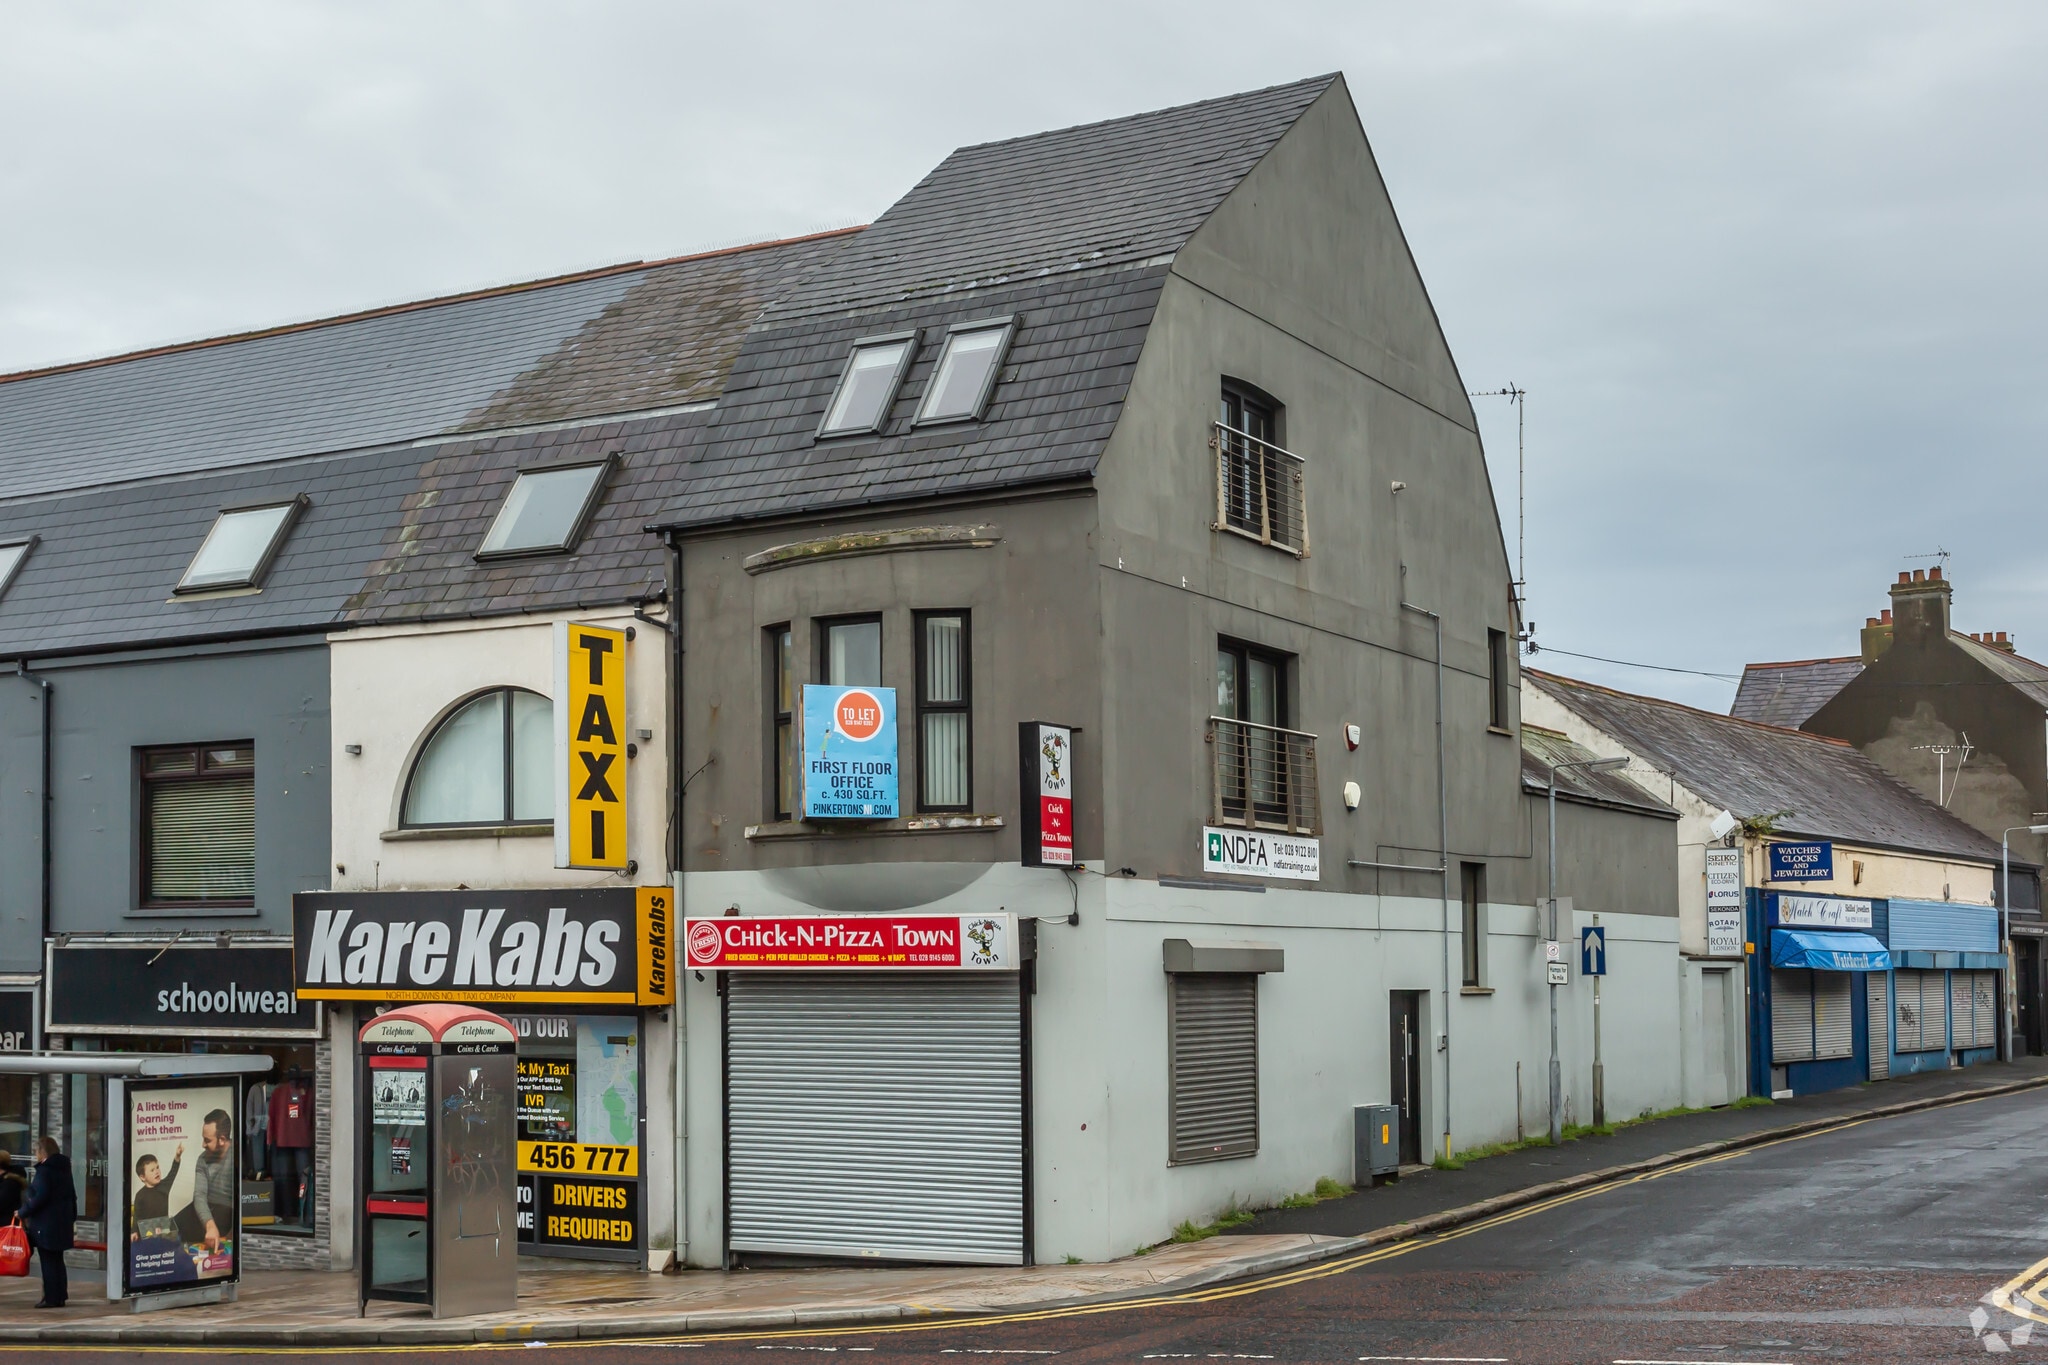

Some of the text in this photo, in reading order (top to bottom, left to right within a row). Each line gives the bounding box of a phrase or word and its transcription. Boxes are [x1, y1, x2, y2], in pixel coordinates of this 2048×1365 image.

[842, 707, 875, 721] TO LET
[576, 633, 619, 859] TAXI
[812, 761, 892, 775] FIRST FLOOR
[831, 776, 874, 788] OFFICE
[821, 789, 887, 801] c. 430 SQ.FT.
[813, 803, 892, 815] PINKERTONSNI.COM
[1222, 834, 1268, 866] NDFA
[1284, 844, 1294, 856] 028
[1778, 846, 1821, 854] WATCHES
[1707, 854, 1737, 862] SEIKO
[1781, 855, 1819, 863] CLOCKS
[1707, 872, 1738, 880] CITIZEN
[1774, 868, 1829, 878] JEWELLERY
[1713, 890, 1739, 898] LORUS
[1708, 919, 1740, 927] ROTARY
[1710, 937, 1740, 945] ROYAL
[837, 953, 850, 962] PIZZA
[887, 954, 906, 962] WRAPS
[909, 953, 917, 962] TEL
[918, 953, 928, 962] 028
[385, 991, 411, 1000] NORTH
[412, 991, 439, 1000] DOWNS
[441, 991, 454, 1000] NO.
[463, 992, 478, 1000] TAXI
[479, 992, 517, 1001] COMPANY
[381, 1026, 415, 1038] Telephone
[461, 1026, 496, 1038] Telephone
[536, 1018, 569, 1038] OUR
[376, 1044, 393, 1053] Coins
[399, 1045, 417, 1053] Cards
[457, 1044, 499, 1053] Coins & Cards
[529, 1063, 545, 1077] My
[547, 1063, 569, 1075] Taxi
[525, 1094, 544, 1106] IVR
[136, 1101, 188, 1112] A little time
[136, 1113, 175, 1124] learning
[136, 1125, 182, 1136] with them
[529, 1144, 630, 1172] 456 777
[553, 1183, 627, 1209] DRIVERS
[547, 1215, 633, 1242] REQUIRED
[149, 1253, 161, 1261] your
[140, 1260, 160, 1268] helping
